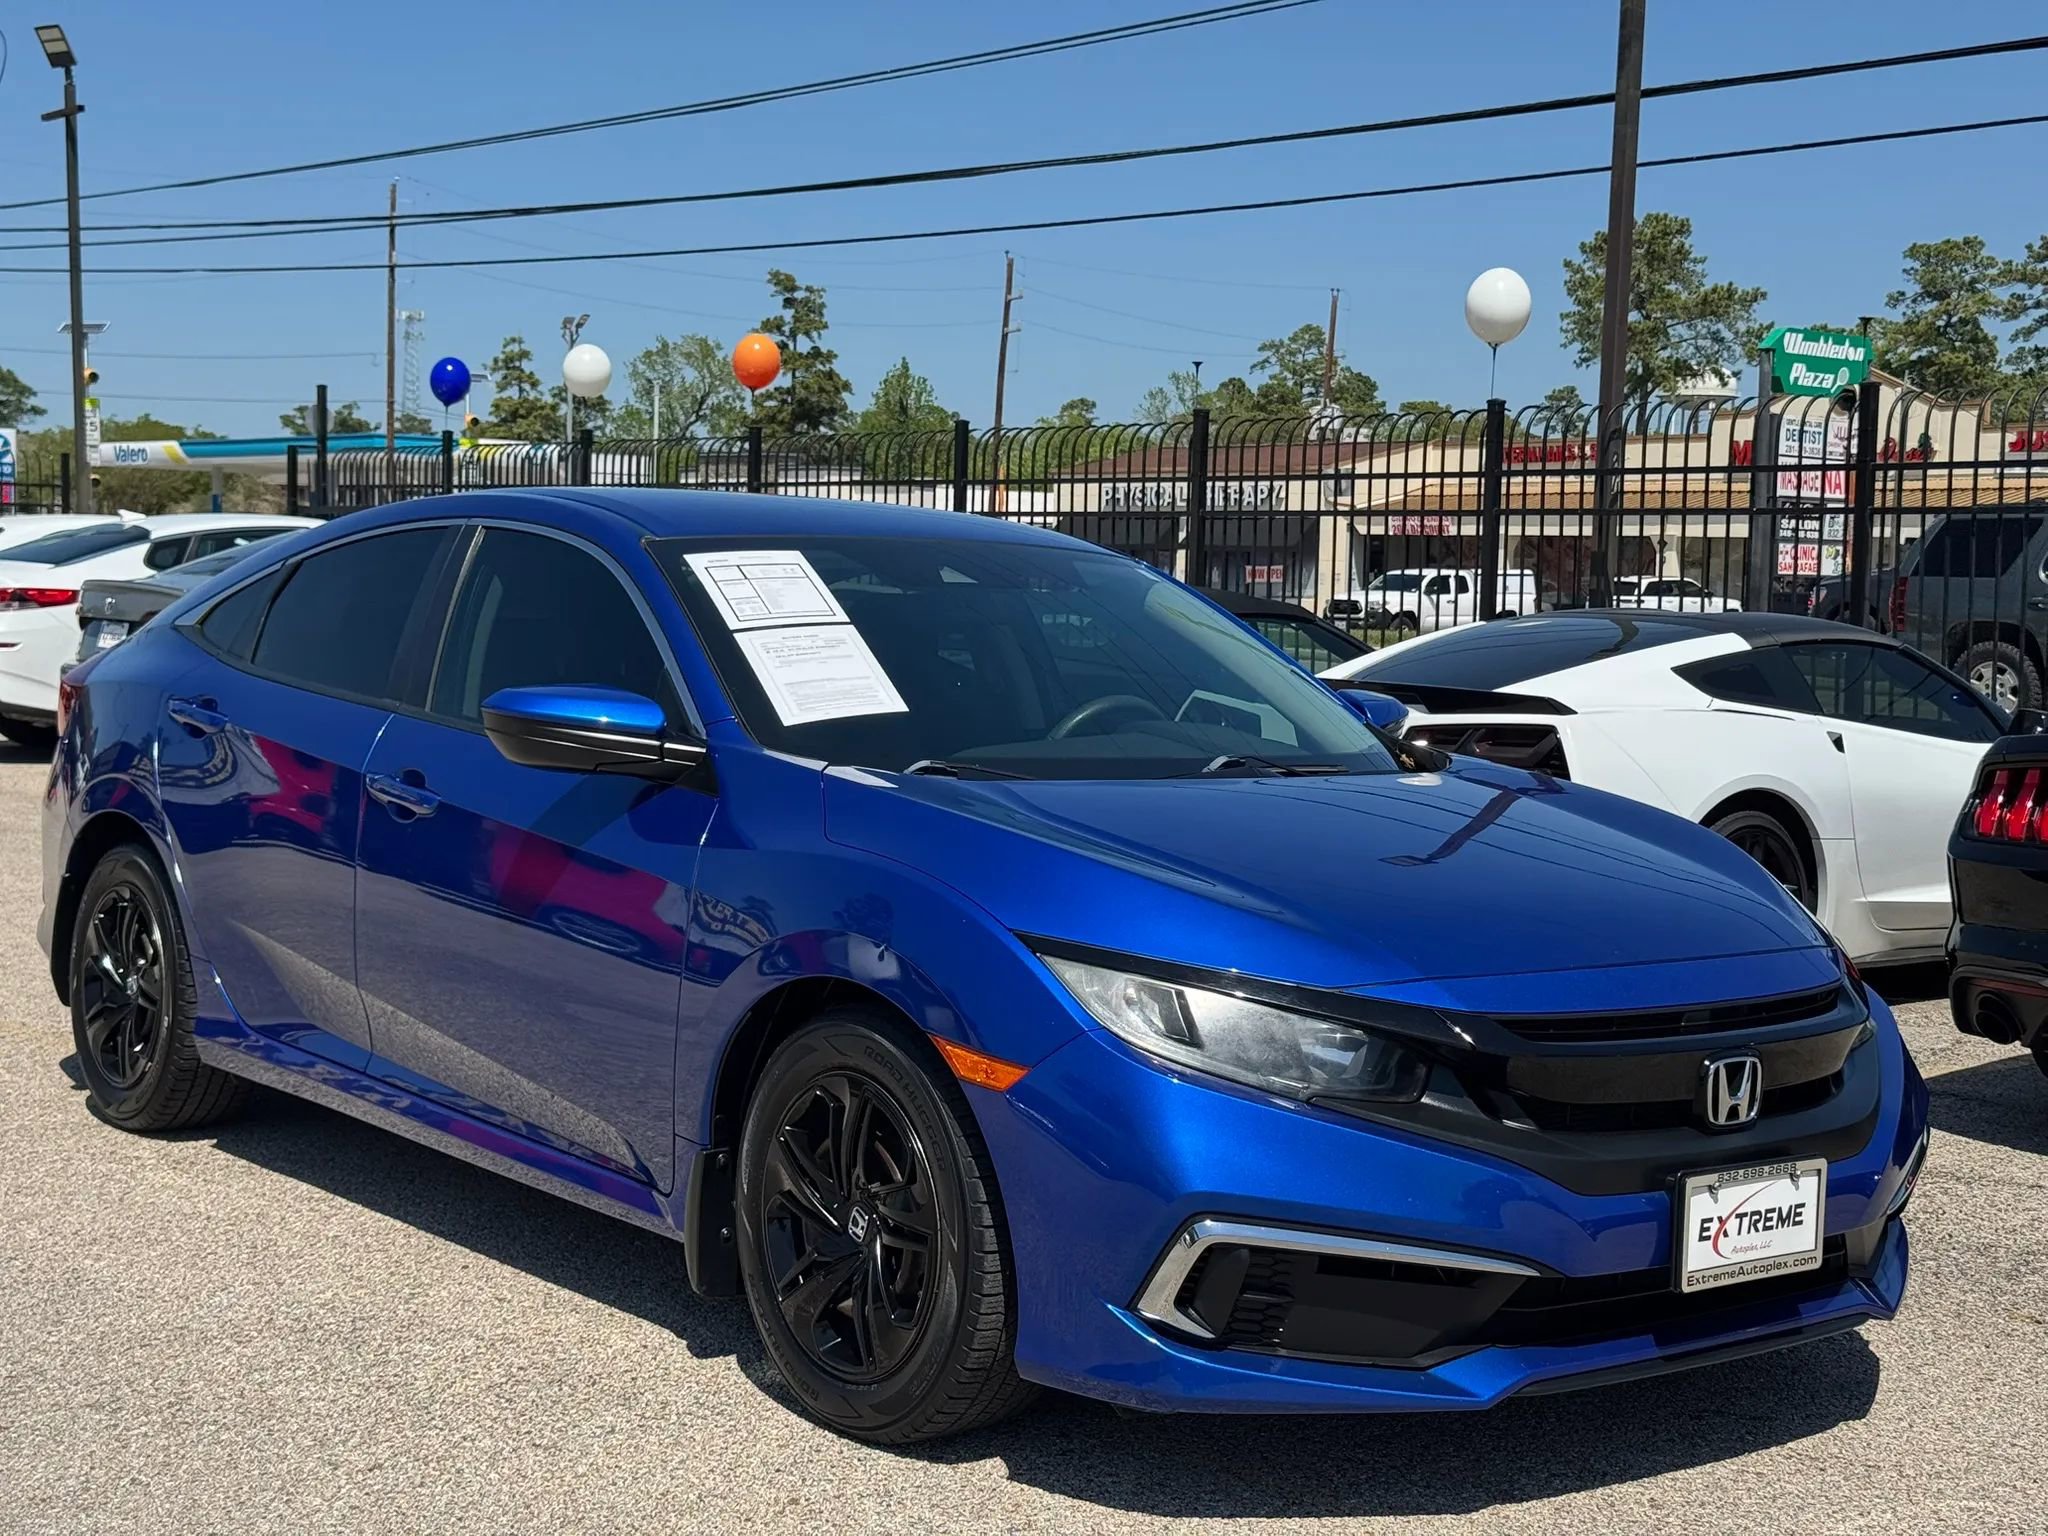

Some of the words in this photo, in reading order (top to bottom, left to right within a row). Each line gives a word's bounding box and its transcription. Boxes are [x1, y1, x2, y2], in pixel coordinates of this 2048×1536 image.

[1783, 331, 1866, 361] Wimbledon
[1789, 362, 1835, 389] Plaza
[1785, 427, 1823, 445] DETIST
[113, 445, 149, 463] Valero
[1780, 470, 1820, 493] MASAGE
[1196, 484, 1284, 507] HERAPY
[1780, 518, 1820, 531] SALON
[1697, 1202, 1806, 1243] EXTREME
[1686, 1255, 1818, 1288] ExtremeAutoplex.com
